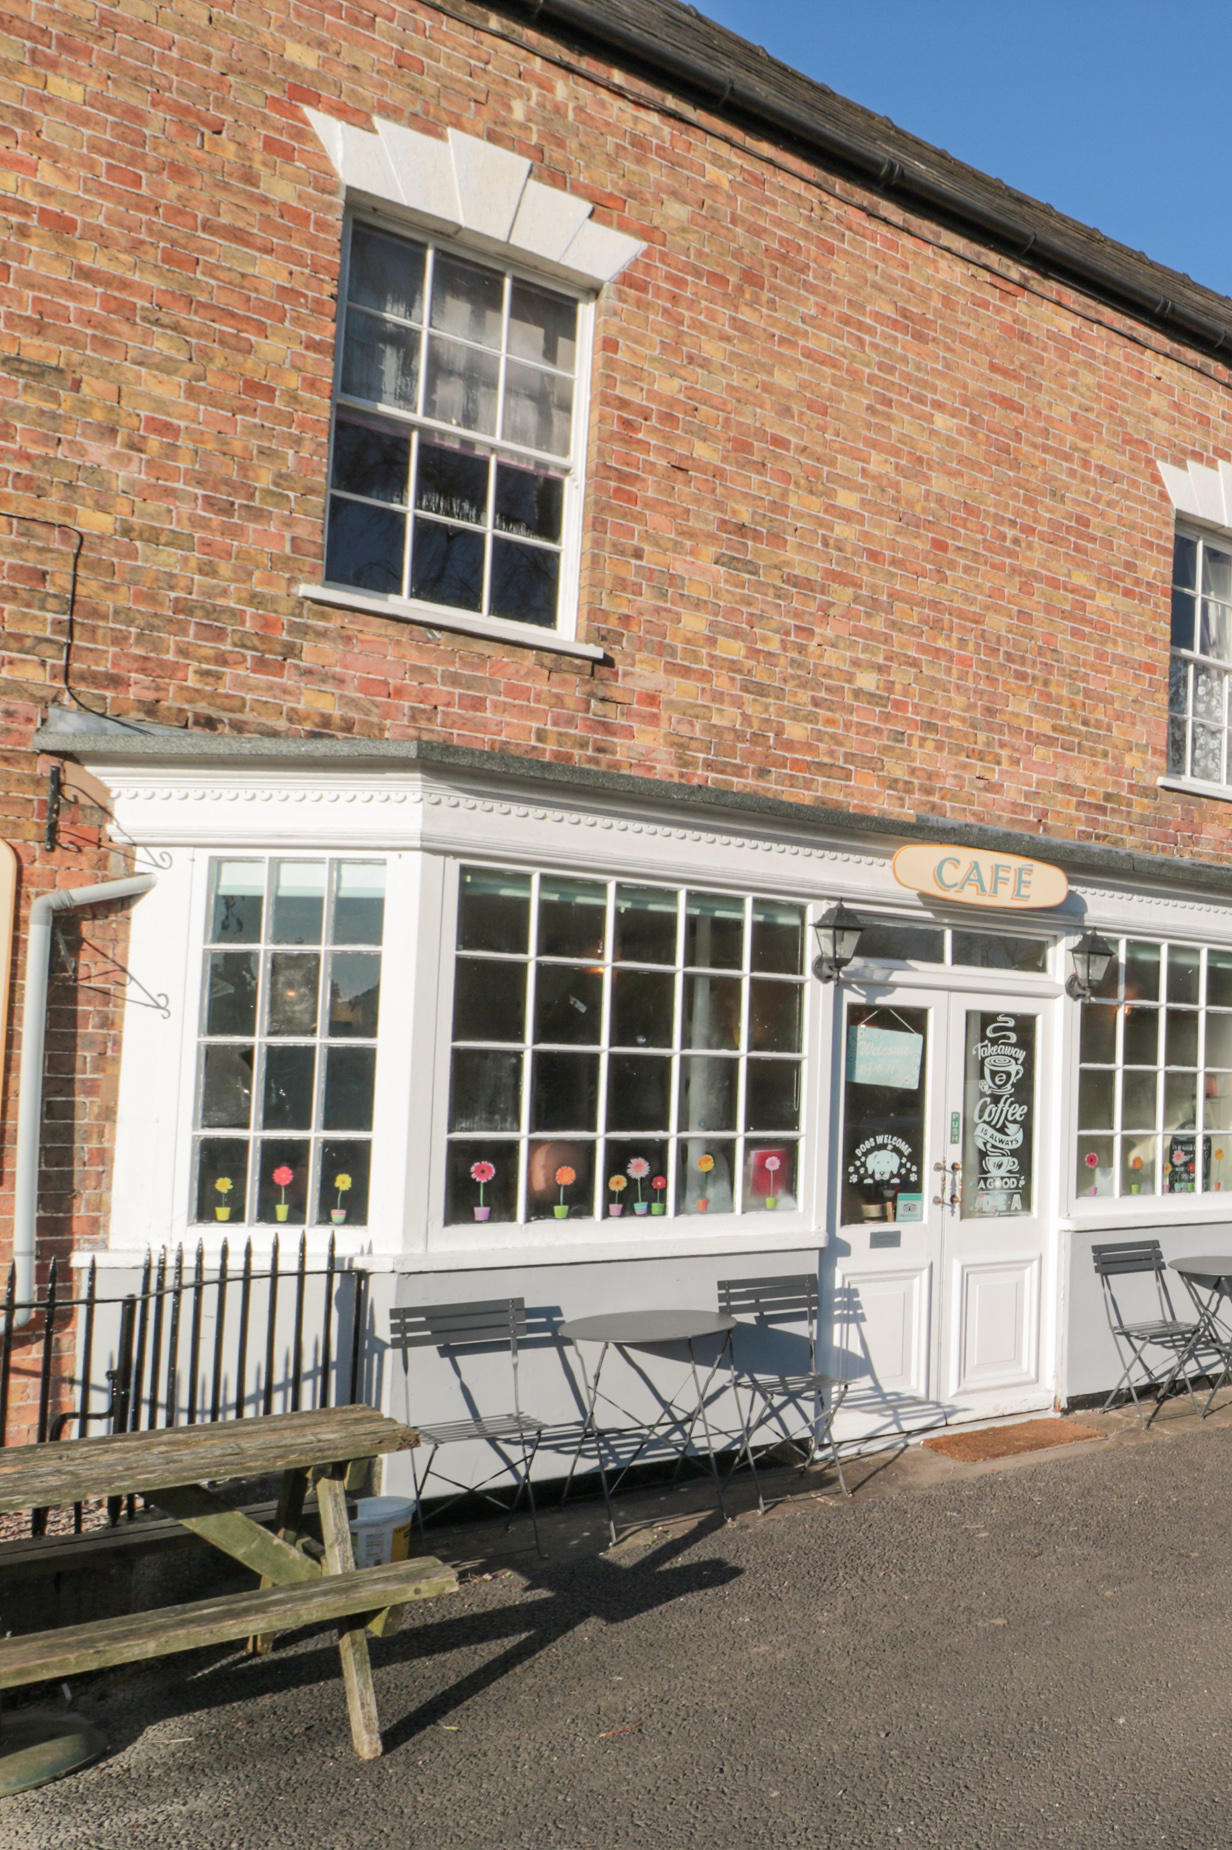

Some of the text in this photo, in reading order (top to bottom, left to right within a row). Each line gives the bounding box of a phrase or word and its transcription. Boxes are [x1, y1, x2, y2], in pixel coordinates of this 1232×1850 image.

[933, 857, 1034, 902] CAFÉ
[972, 1040, 1026, 1064] Takeaway
[974, 1095, 1027, 1128] Coffee
[855, 1135, 912, 1157] DOGS WELCOME
[981, 1127, 1019, 1147] IS ALWAYS
[978, 1178, 1017, 1189] A GOOD
